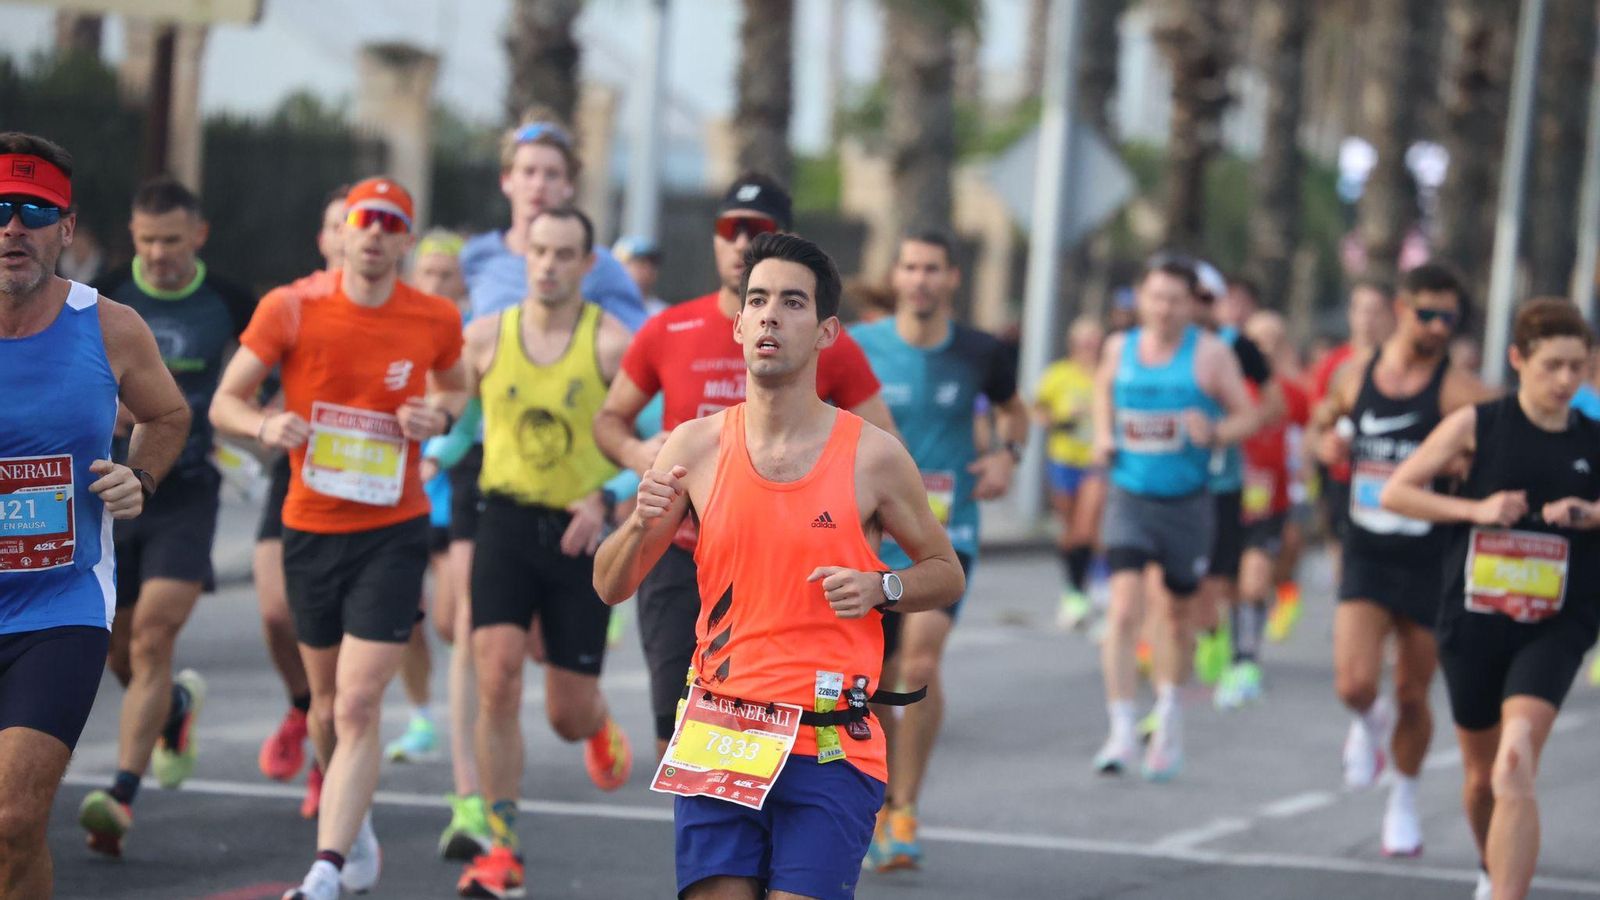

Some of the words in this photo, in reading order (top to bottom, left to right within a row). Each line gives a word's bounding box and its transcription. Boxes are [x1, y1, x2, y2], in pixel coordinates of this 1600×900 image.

[17, 521, 46, 529] PAUSA
[33, 542, 57, 552] 42K
[718, 698, 792, 727] GENERALI
[705, 731, 761, 760] 7833
